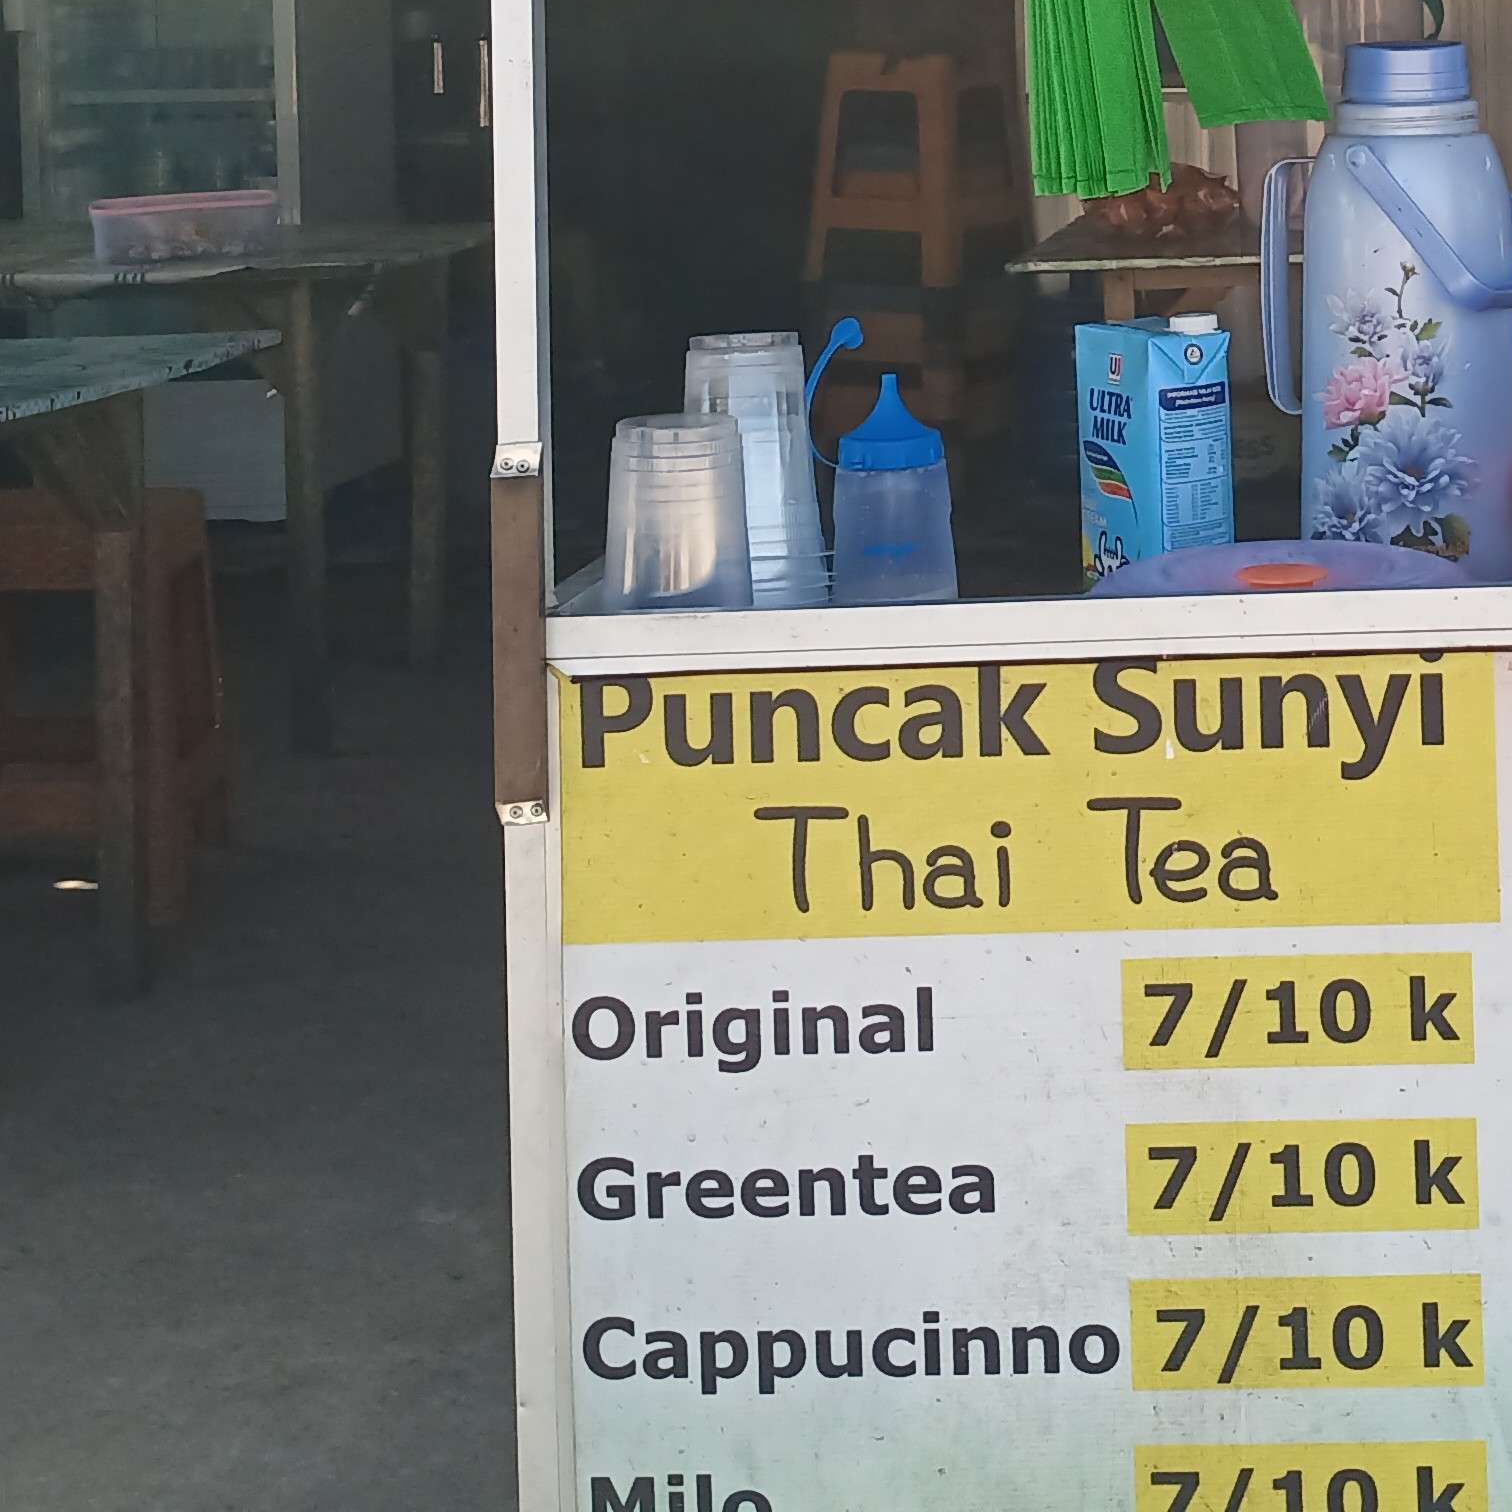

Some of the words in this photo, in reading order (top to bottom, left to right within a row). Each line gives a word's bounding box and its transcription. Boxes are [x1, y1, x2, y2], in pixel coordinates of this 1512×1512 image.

[1090, 387, 1132, 419] ULTRA
[1092, 415, 1127, 445] MILK
[579, 664, 1050, 769] Puncak
[1092, 651, 1446, 780] Sunyi
[754, 806, 1013, 913] Thai
[1087, 797, 1278, 905] Tea
[572, 987, 935, 1073] Original
[1144, 978, 1371, 1059] 7/10
[1410, 976, 1460, 1042] k
[577, 1150, 997, 1220] Greentea
[1146, 1142, 1376, 1222] 7/10
[1413, 1139, 1466, 1205] k
[582, 1310, 1121, 1394] Cappucinno
[1155, 1303, 1385, 1384] 7/10
[1423, 1302, 1474, 1368] k
[1415, 1465, 1470, 1512] k
